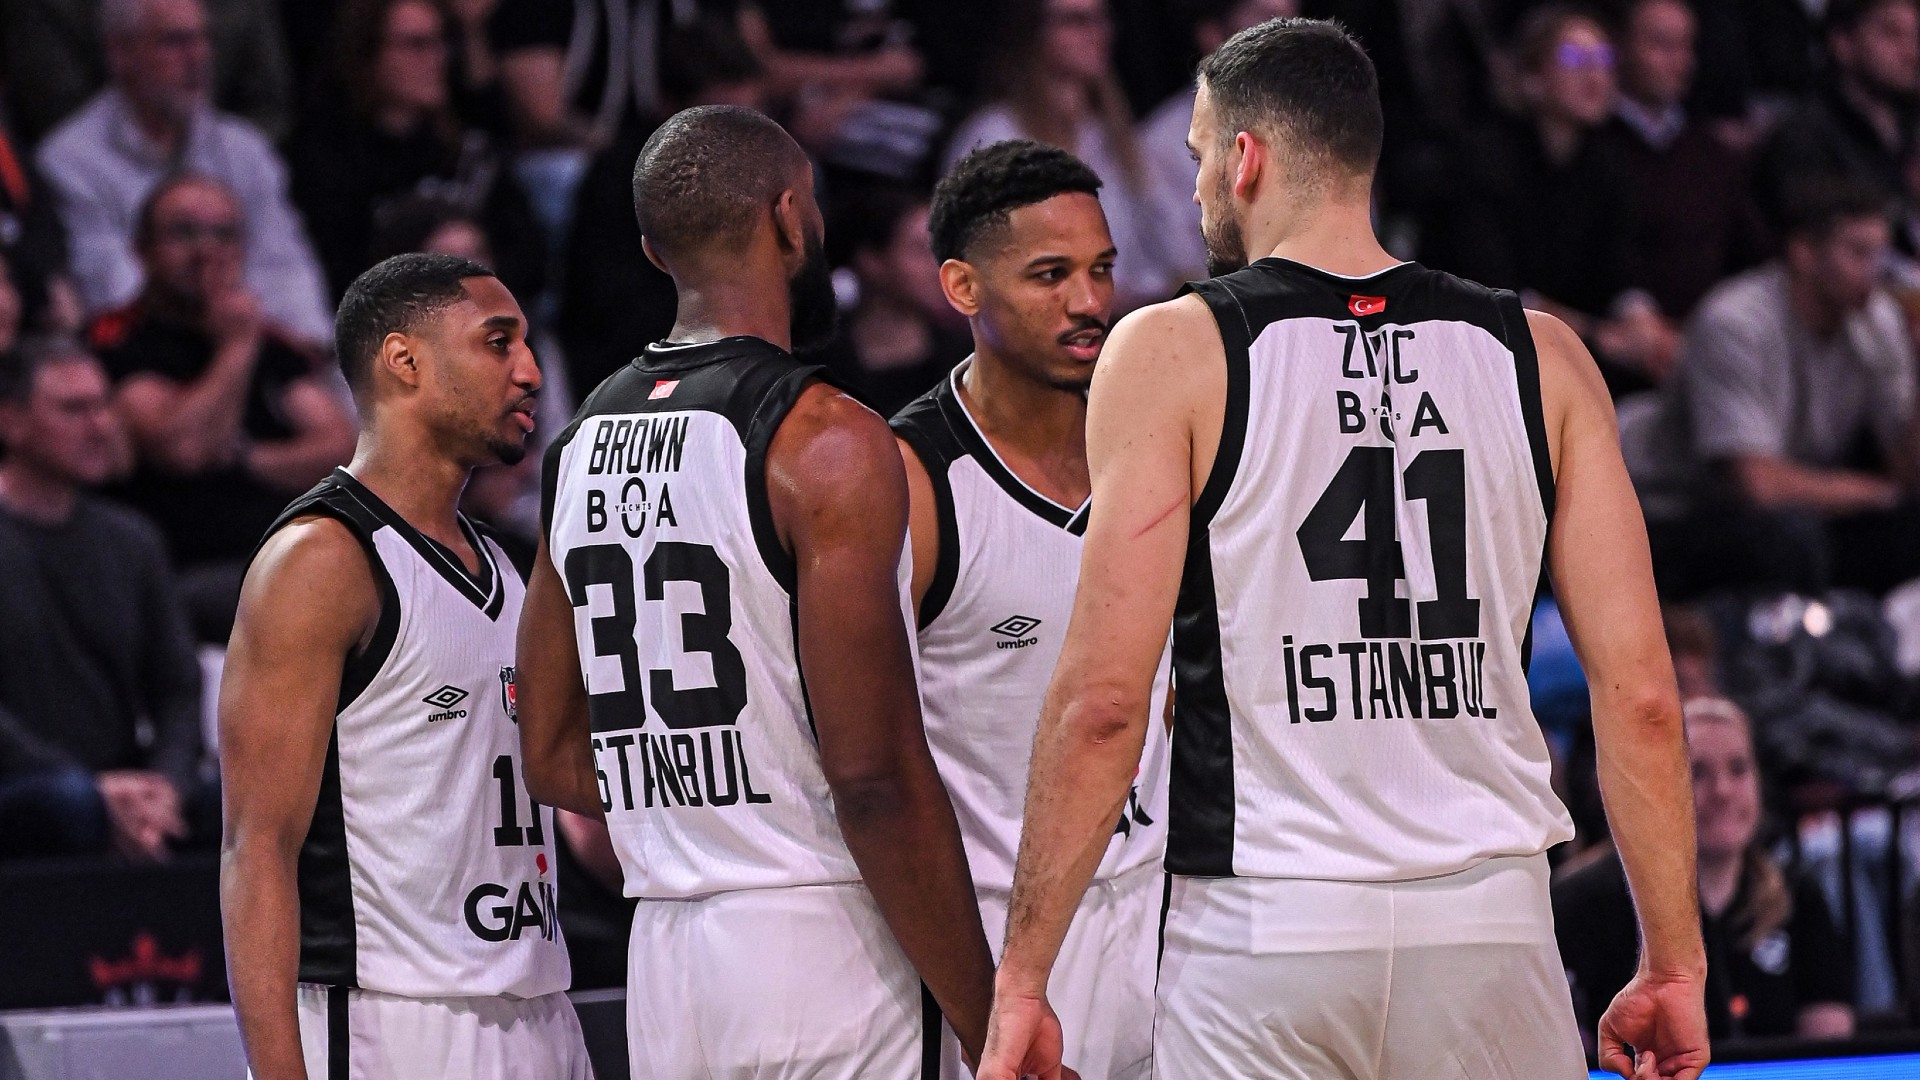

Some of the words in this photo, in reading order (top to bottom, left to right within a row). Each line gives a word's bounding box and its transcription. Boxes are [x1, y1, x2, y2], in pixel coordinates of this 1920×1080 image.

[588, 417, 690, 475] BROWN
[587, 477, 678, 539] BOA
[615, 503, 652, 513] YACHTS
[1296, 446, 1480, 641] 41
[564, 541, 748, 733] 33
[996, 636, 1038, 649] umbro
[1282, 635, 1498, 724] İSTANBUL
[428, 709, 467, 722] umbro
[592, 730, 773, 813] STANBUL
